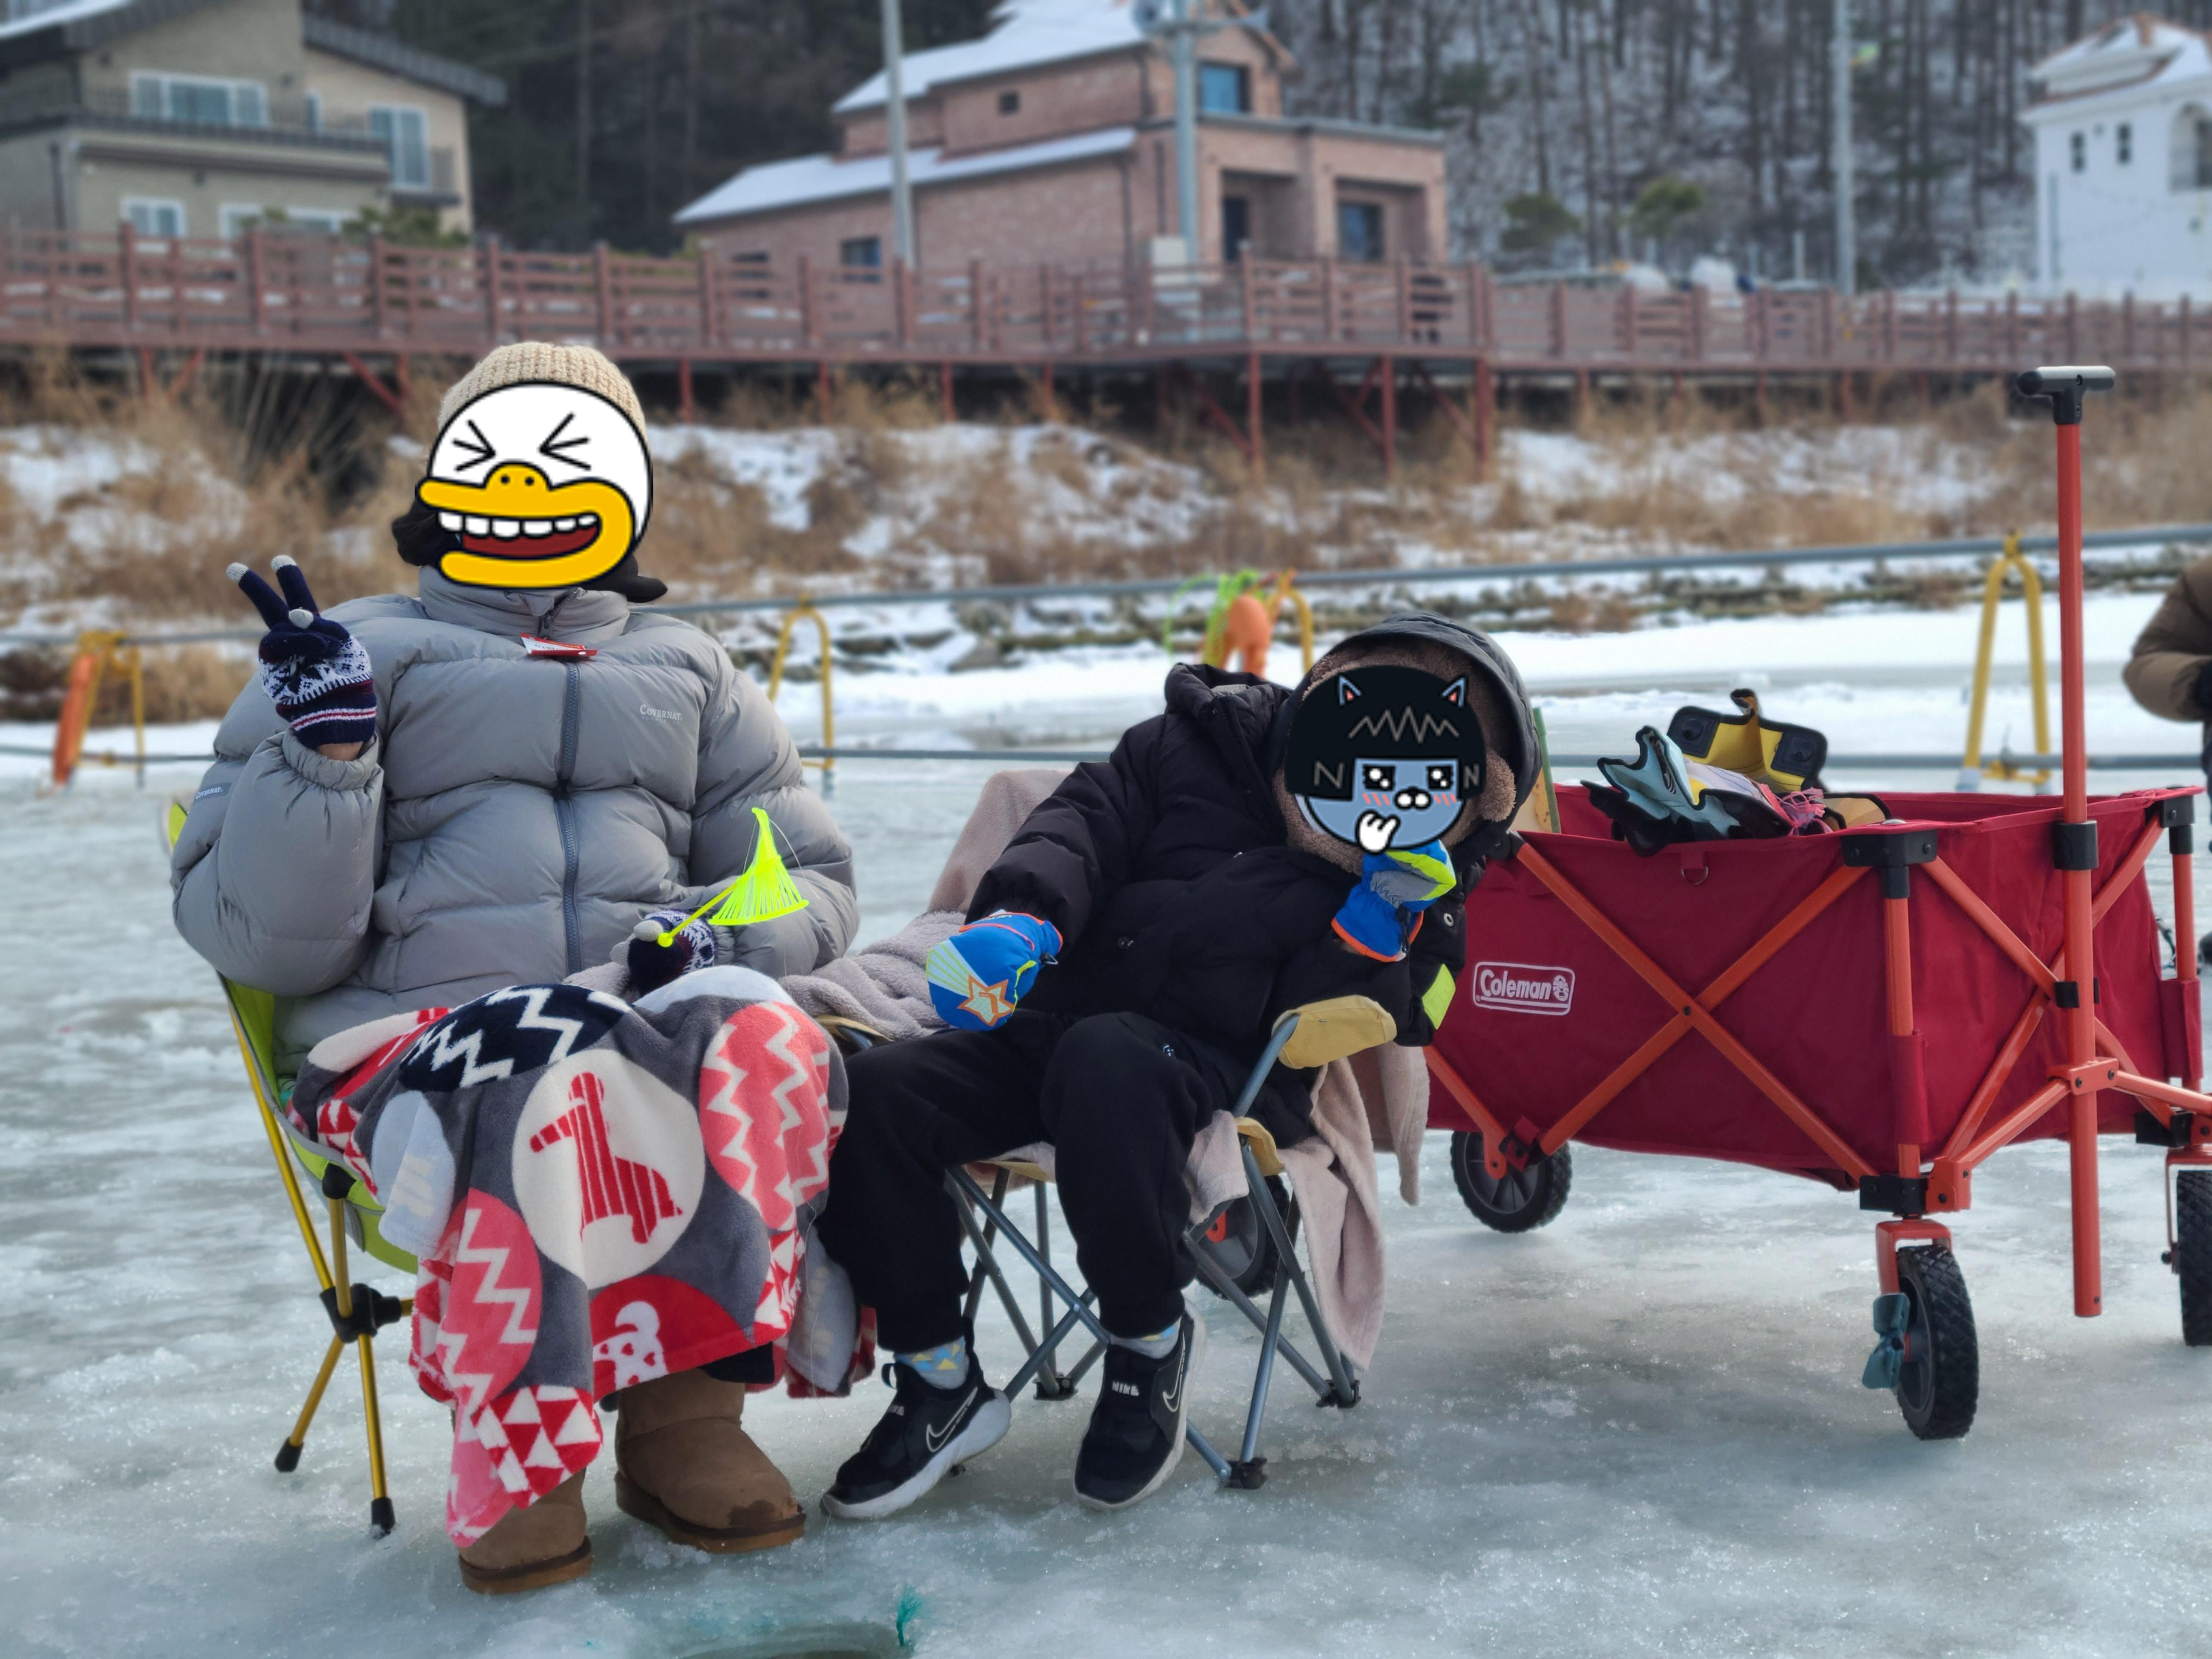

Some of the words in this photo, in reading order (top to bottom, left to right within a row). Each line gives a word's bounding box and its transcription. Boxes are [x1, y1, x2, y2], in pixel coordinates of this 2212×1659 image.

[639, 703, 682, 720] COVERNAT
[1480, 969, 1552, 1001] Coleman
[1112, 1380, 1140, 1397] NIKE
